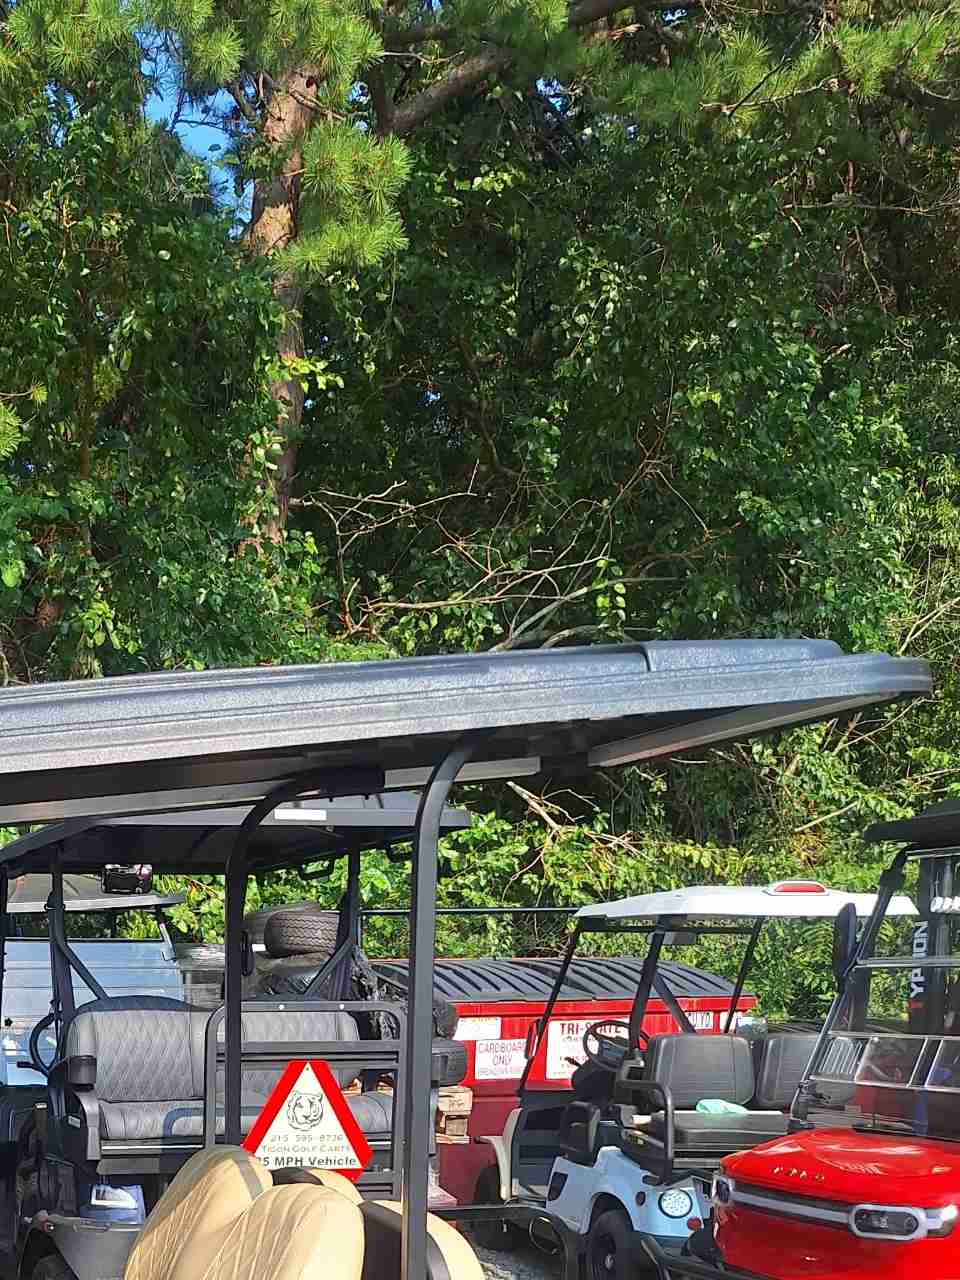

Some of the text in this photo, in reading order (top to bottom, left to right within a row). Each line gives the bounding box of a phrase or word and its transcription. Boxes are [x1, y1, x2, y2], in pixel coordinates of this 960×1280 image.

[560, 1022, 622, 1036] TRI-SATE
[491, 1054, 513, 1067] ONLY
[274, 1156, 304, 1168] MPH
[308, 1156, 357, 1167] Vehicle
